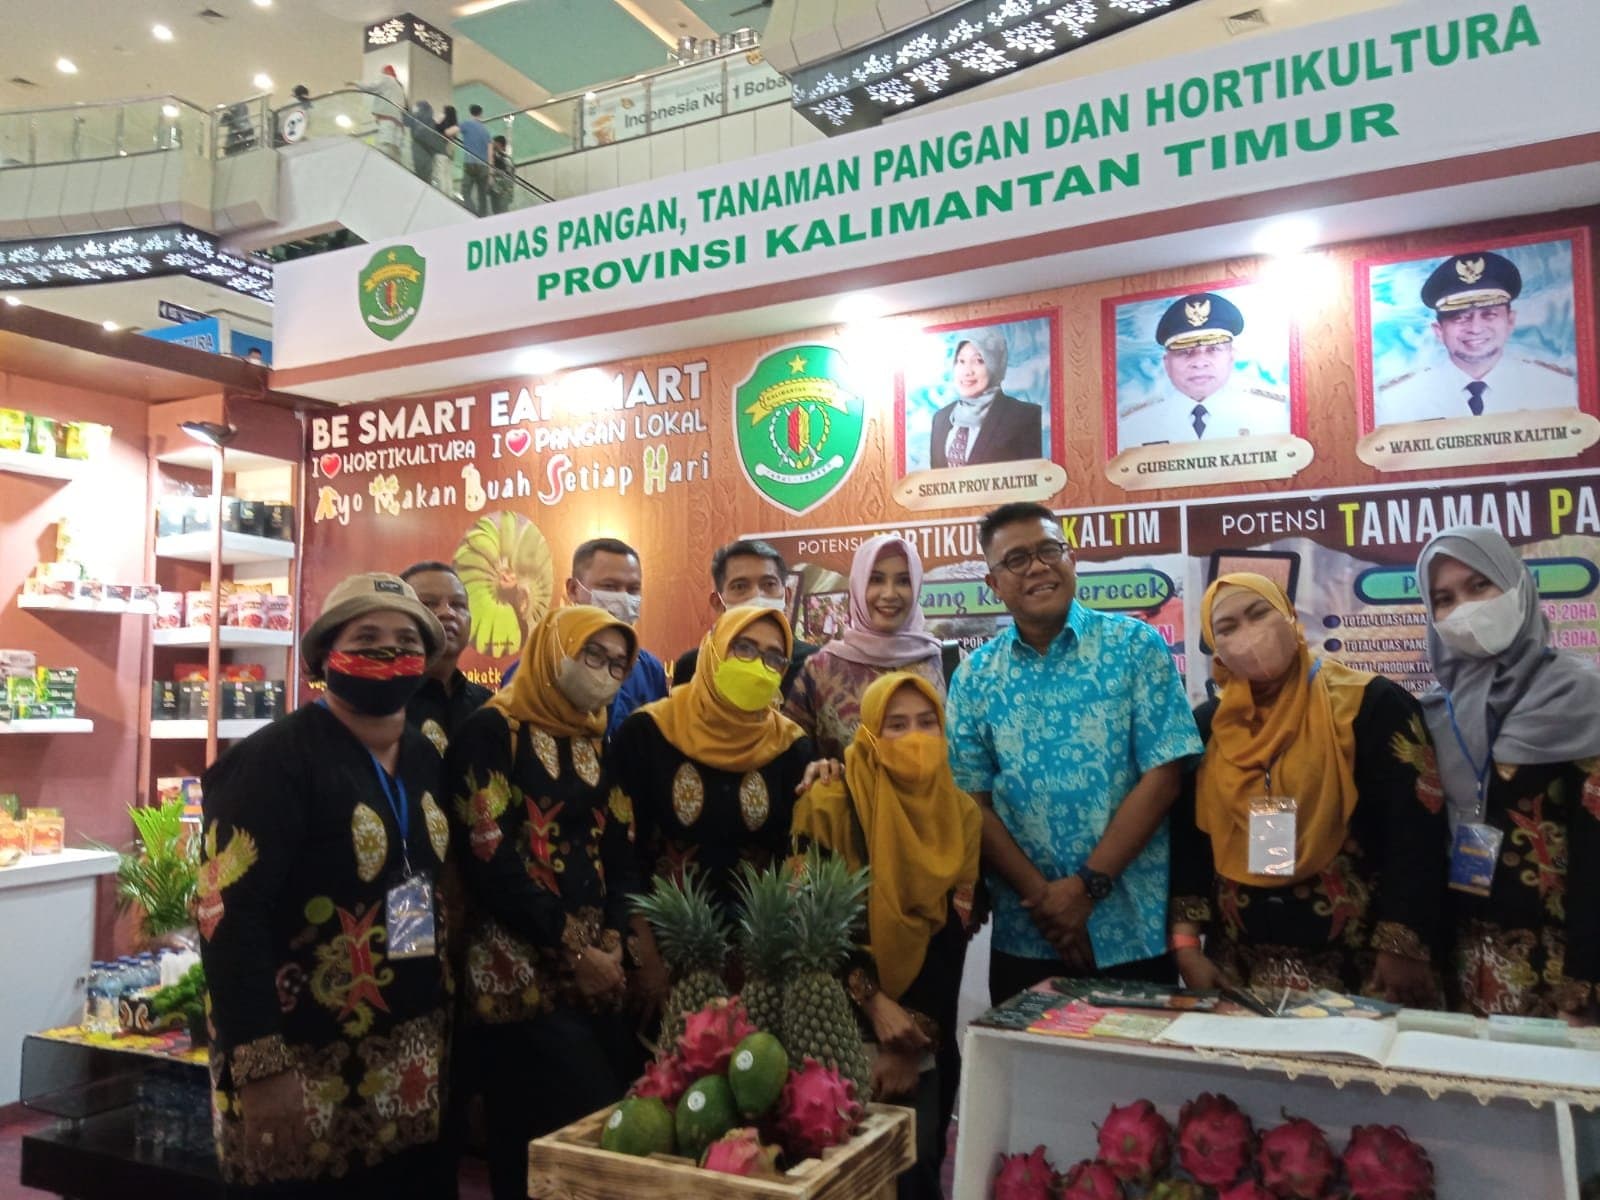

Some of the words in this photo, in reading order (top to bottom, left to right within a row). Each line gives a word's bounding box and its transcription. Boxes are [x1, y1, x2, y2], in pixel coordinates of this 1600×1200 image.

[624, 97, 700, 129] Indonesia
[744, 74, 787, 97] Boba
[467, 225, 548, 272] DINAS
[558, 197, 687, 253] PANGAN,
[697, 156, 860, 222] TANAMAN
[874, 117, 1029, 187] PANGAN
[1045, 93, 1129, 149] DAN
[1146, 4, 1541, 127] HORTIKULTURA
[537, 234, 747, 301] PROVINSI
[766, 152, 1140, 259] KALIMANTAN
[1164, 102, 1400, 178] TIMUR
[312, 415, 350, 451] BE
[358, 396, 476, 445] SMART
[490, 383, 556, 427] EAT
[343, 440, 476, 474] HORTIKULTURA
[534, 418, 626, 453] PANGAN
[634, 408, 708, 440] LOKAL
[1389, 439, 1435, 454] WAKIL
[1437, 430, 1512, 450] GUBERNUR
[1514, 426, 1568, 443] KALTIM
[1136, 456, 1218, 475] GUBERNUR
[1220, 450, 1278, 467] KALTIM
[314, 485, 363, 526] Ayo
[368, 473, 457, 516] Makan
[461, 462, 531, 513] Buah
[536, 453, 633, 506] Setiap
[642, 443, 709, 496] Hari
[918, 482, 957, 498] SEKDA
[957, 477, 990, 493] PROV
[991, 474, 1038, 490] KALTIM
[1062, 510, 1160, 549] KALTIM
[1222, 508, 1325, 536] POTENSI
[1338, 490, 1532, 547] TANAMAN
[1077, 577, 1166, 601] erecek
[1342, 613, 1371, 627] TOTAL
[1373, 613, 1400, 627] LUAS
[1402, 613, 1428, 627] TANA
[1541, 603, 1597, 620] 8.20HA
[1344, 639, 1373, 652] TOTAL
[1375, 639, 1401, 652] LUAS
[1402, 639, 1428, 652] PANE
[1377, 660, 1433, 673] PRODUKTIV
